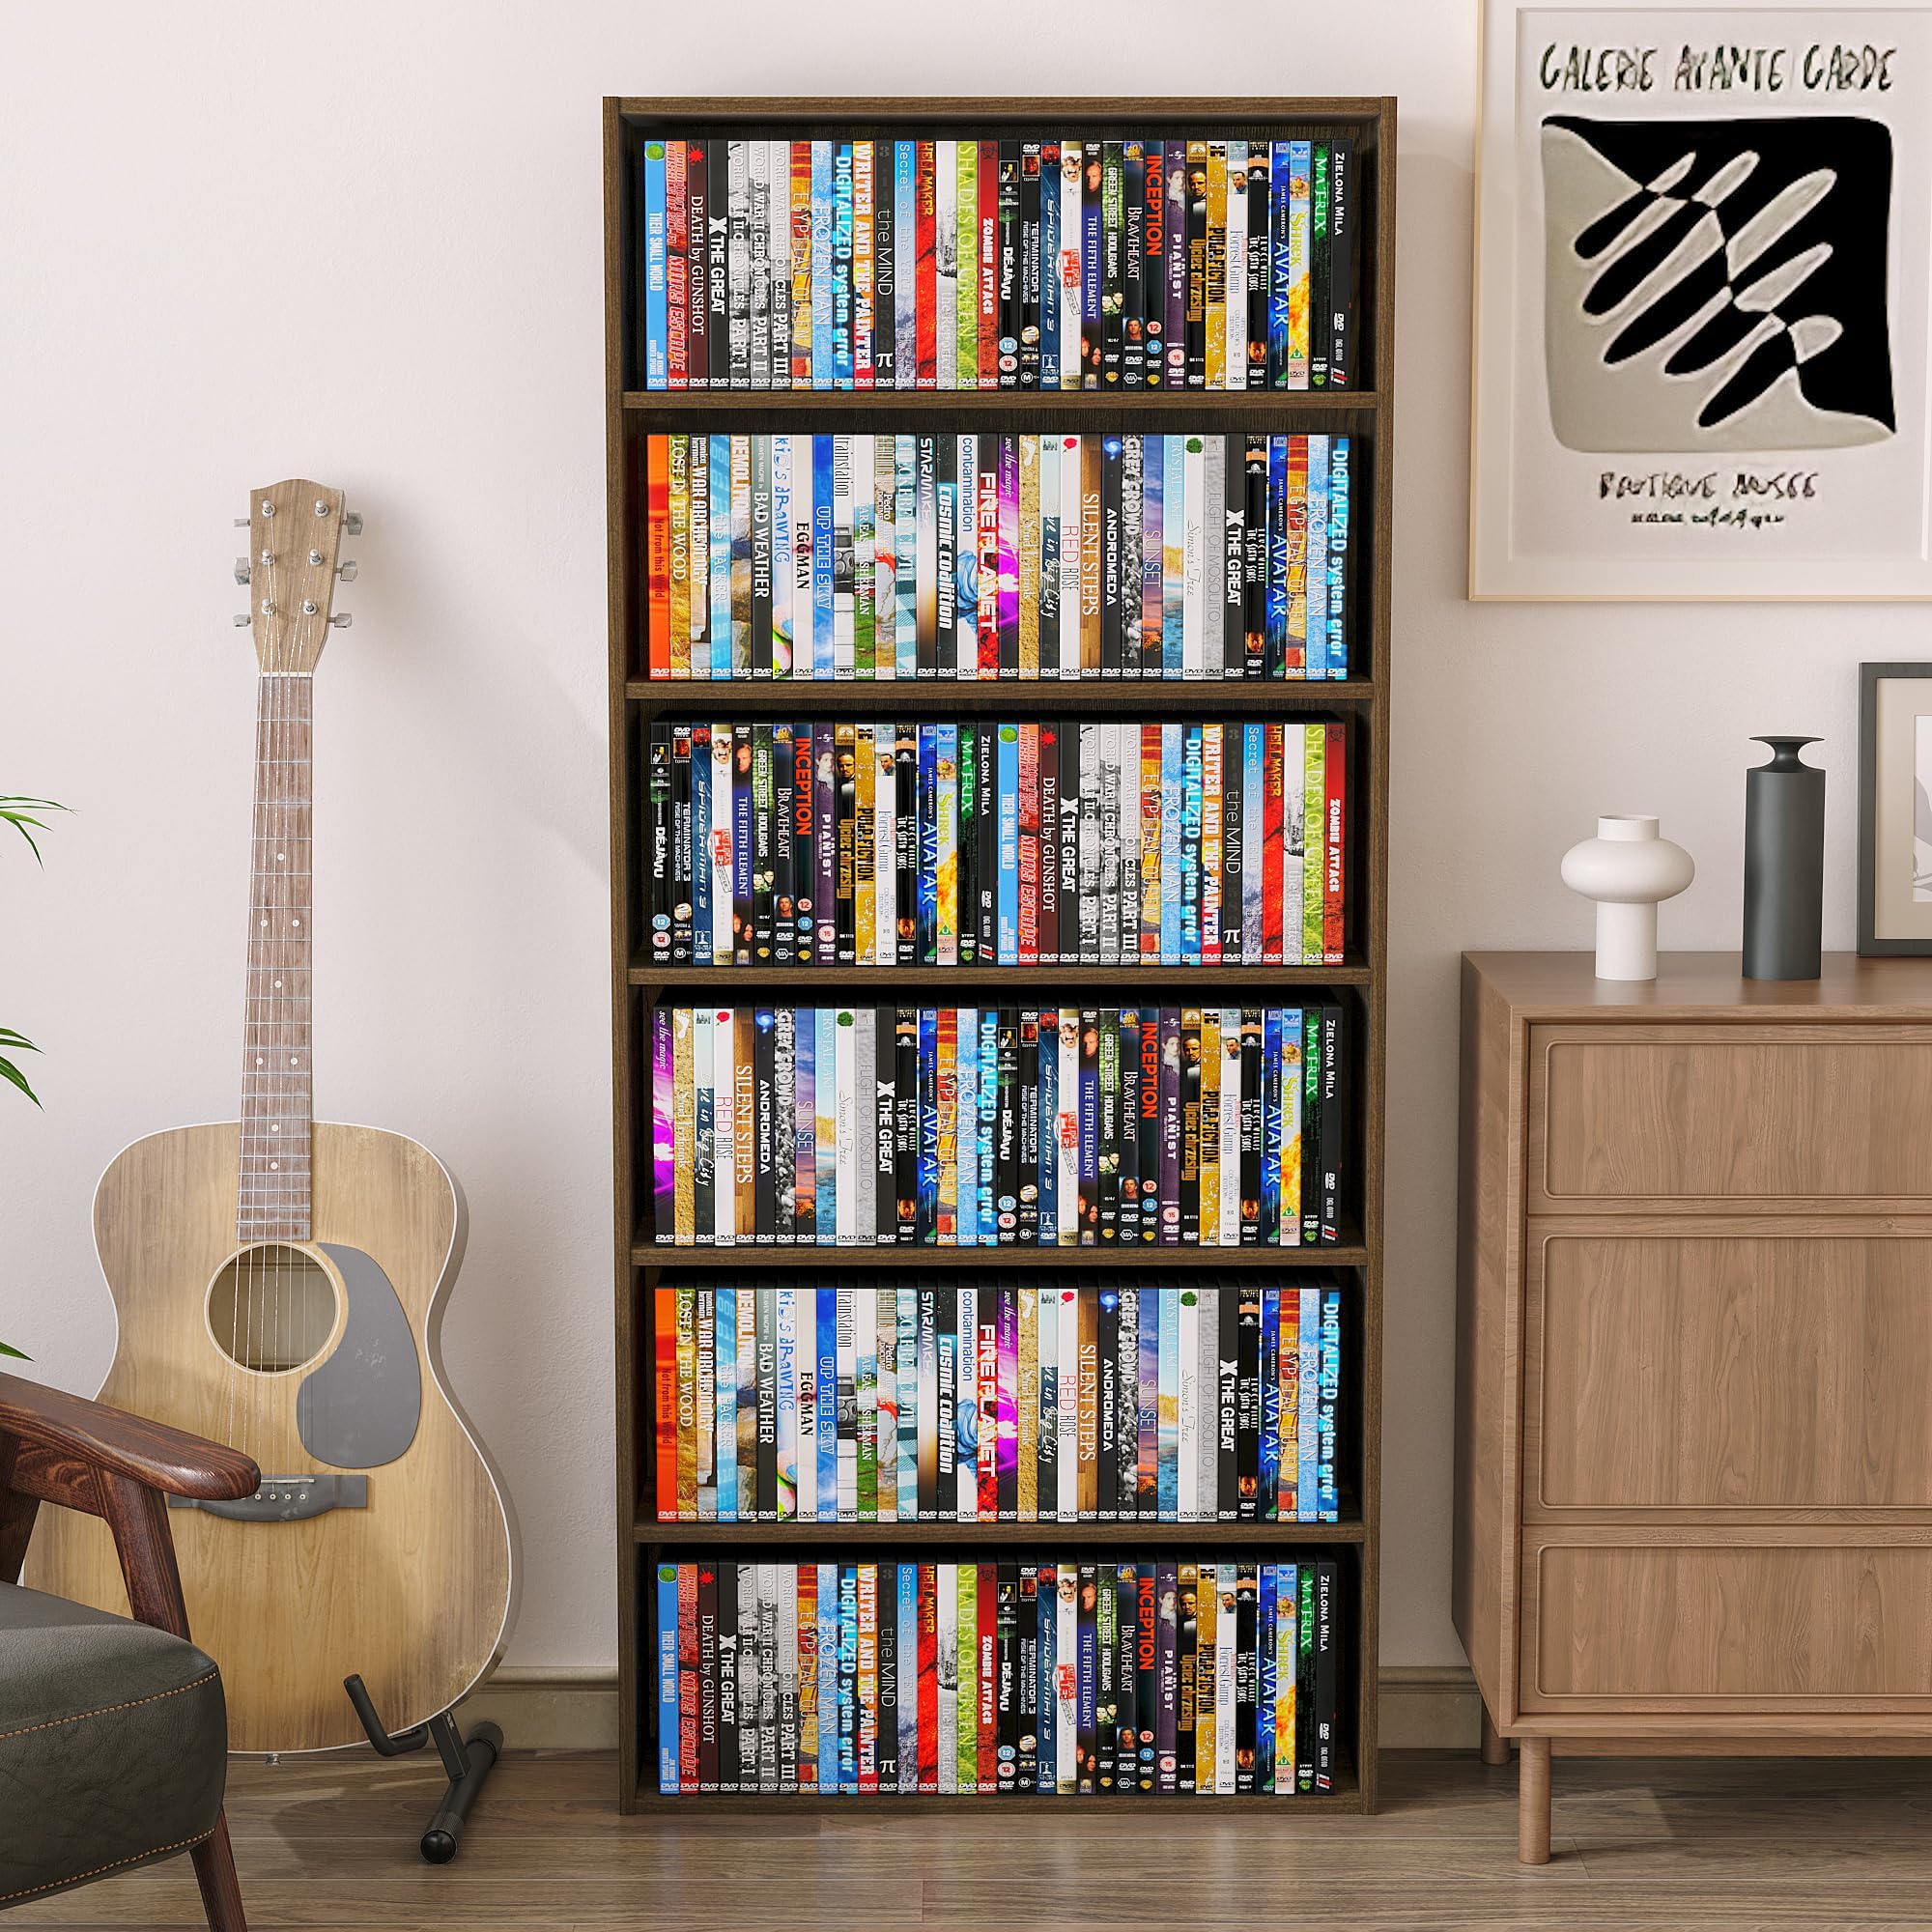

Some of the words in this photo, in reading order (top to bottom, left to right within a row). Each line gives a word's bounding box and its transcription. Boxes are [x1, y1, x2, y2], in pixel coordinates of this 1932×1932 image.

[753, 146, 765, 189] WORLD
[855, 143, 871, 215] WRITER
[919, 142, 934, 216] HELLMAKER
[648, 212, 664, 236] THEIR
[691, 195, 703, 243] DEATH
[708, 216, 727, 235] X
[753, 191, 765, 218] WAR
[753, 221, 765, 230] II
[835, 156, 851, 260] DIGITALIZED
[877, 209, 892, 242] the
[1145, 154, 1162, 256] INCEPTION
[649, 237, 663, 263] SMALL
[689, 246, 702, 262] by
[710, 236, 724, 264] THE
[855, 220, 870, 255] AND
[982, 217, 993, 264] ZOMBIE
[1022, 237, 1029, 249] OF
[1031, 221, 1039, 293] TERMINATOR
[649, 264, 663, 291] WORLD
[668, 255, 685, 304] MARS
[710, 267, 724, 315] GREAT
[753, 232, 765, 309] CHRONICLES
[855, 259, 870, 294] THE
[877, 247, 893, 296] MIND
[982, 267, 994, 315] ATTACK
[691, 265, 704, 335] GUNSHOT
[833, 264, 849, 323] system
[1031, 295, 1039, 303] 3
[669, 306, 686, 371] ESCAPE
[753, 316, 767, 356] PART
[836, 328, 850, 366] error
[855, 298, 871, 370] PAINTER
[753, 358, 767, 372] II
[671, 438, 685, 476] LOST
[691, 437, 700, 467] herman
[698, 437, 707, 464] monica
[1005, 437, 1013, 452] see
[1005, 453, 1018, 469] the
[1124, 438, 1140, 477] GREY
[671, 478, 685, 496] IN
[692, 466, 707, 497] WAR
[834, 436, 853, 497] trainstation
[962, 437, 976, 532] contamination
[999, 469, 1014, 497] magic
[672, 499, 686, 528] THE
[753, 492, 769, 524] BAD
[816, 505, 831, 529] UP
[939, 485, 955, 547] cosmic
[980, 472, 996, 526] FIRE
[1124, 480, 1140, 535] CROWD
[1226, 509, 1244, 526] X
[692, 499, 708, 585] ARCHEOLOGY
[1062, 526, 1079, 563] RED
[1082, 494, 1098, 557] SILENT
[1227, 528, 1241, 556] THE
[672, 531, 686, 580] WOOD
[754, 527, 769, 598] WEATHER
[796, 522, 810, 589] EGGMAN
[816, 534, 831, 569] THE
[1106, 508, 1118, 607] ANDROMEDA
[1144, 529, 1161, 587] SUNSET
[816, 574, 831, 609] SKY
[938, 551, 955, 630] coalition
[980, 531, 997, 633] PLANET
[1062, 568, 1079, 591] ROSE
[1082, 561, 1099, 615] STEPS
[1227, 559, 1241, 607] GREAT
[757, 749, 767, 777] GREEN
[961, 740, 974, 812] MATRIX
[738, 797, 748, 819] THE
[757, 779, 768, 809] STREET
[795, 737, 811, 836] INCEPTION
[738, 820, 748, 850] FIFTH
[758, 811, 768, 857] HOOLIGANS
[857, 808, 873, 835] PULP
[822, 813, 832, 877] PIANIST
[857, 838, 874, 882] FICTION
[922, 821, 936, 905] AVATAR
[738, 852, 748, 896] ELEMENT
[698, 895, 706, 909] 3
[860, 1065, 872, 1101] FLIGHT
[1141, 1022, 1158, 1118] INCEPTION
[716, 1096, 733, 1133] RED
[735, 1065, 753, 1127] SILENT
[838, 1091, 853, 1134] Simon's
[860, 1105, 872, 1122] OF
[939, 1058, 954, 1137] EGYPTIAN
[958, 1070, 976, 1138] FROZEN
[716, 1137, 733, 1159] ROSE
[759, 1079, 771, 1175] ANDROMEDA
[736, 1131, 753, 1183] STEPS
[838, 1138, 854, 1165] Tree
[860, 1124, 873, 1190] MOSQUITO
[960, 1146, 976, 1184] MAN
[737, 1291, 753, 1369] DEMOLITION
[961, 1291, 975, 1381] contamination
[980, 1324, 995, 1376] FIRE
[662, 1368, 671, 1382] Not
[759, 1343, 774, 1373] BAD
[662, 1383, 672, 1404] from
[662, 1405, 672, 1419] this
[759, 1377, 774, 1444] WEATHER
[800, 1372, 813, 1436] EGGMAN
[1140, 1379, 1156, 1435] SUNSET
[662, 1421, 672, 1444] World
[980, 1380, 996, 1478] PLANET
[860, 1566, 875, 1634] WRITER
[702, 1614, 714, 1659] DEATH
[719, 1634, 737, 1651] X
[881, 1627, 894, 1658] the
[1082, 1633, 1093, 1655] THE
[1139, 1577, 1154, 1670] INCEPTION
[699, 1662, 713, 1676] by
[721, 1652, 734, 1678] THE
[860, 1637, 874, 1669] AND
[981, 1634, 992, 1677] ZOMBIE
[1082, 1656, 1092, 1685] FIFTH
[721, 1681, 734, 1725] GREAT
[860, 1674, 874, 1704] THE
[881, 1662, 895, 1707] MIND
[981, 1681, 993, 1724] ATTACK
[702, 1679, 715, 1744] GUNSHOT
[1082, 1686, 1092, 1728] ELEMENT
[860, 1709, 875, 1776] PAINTER
